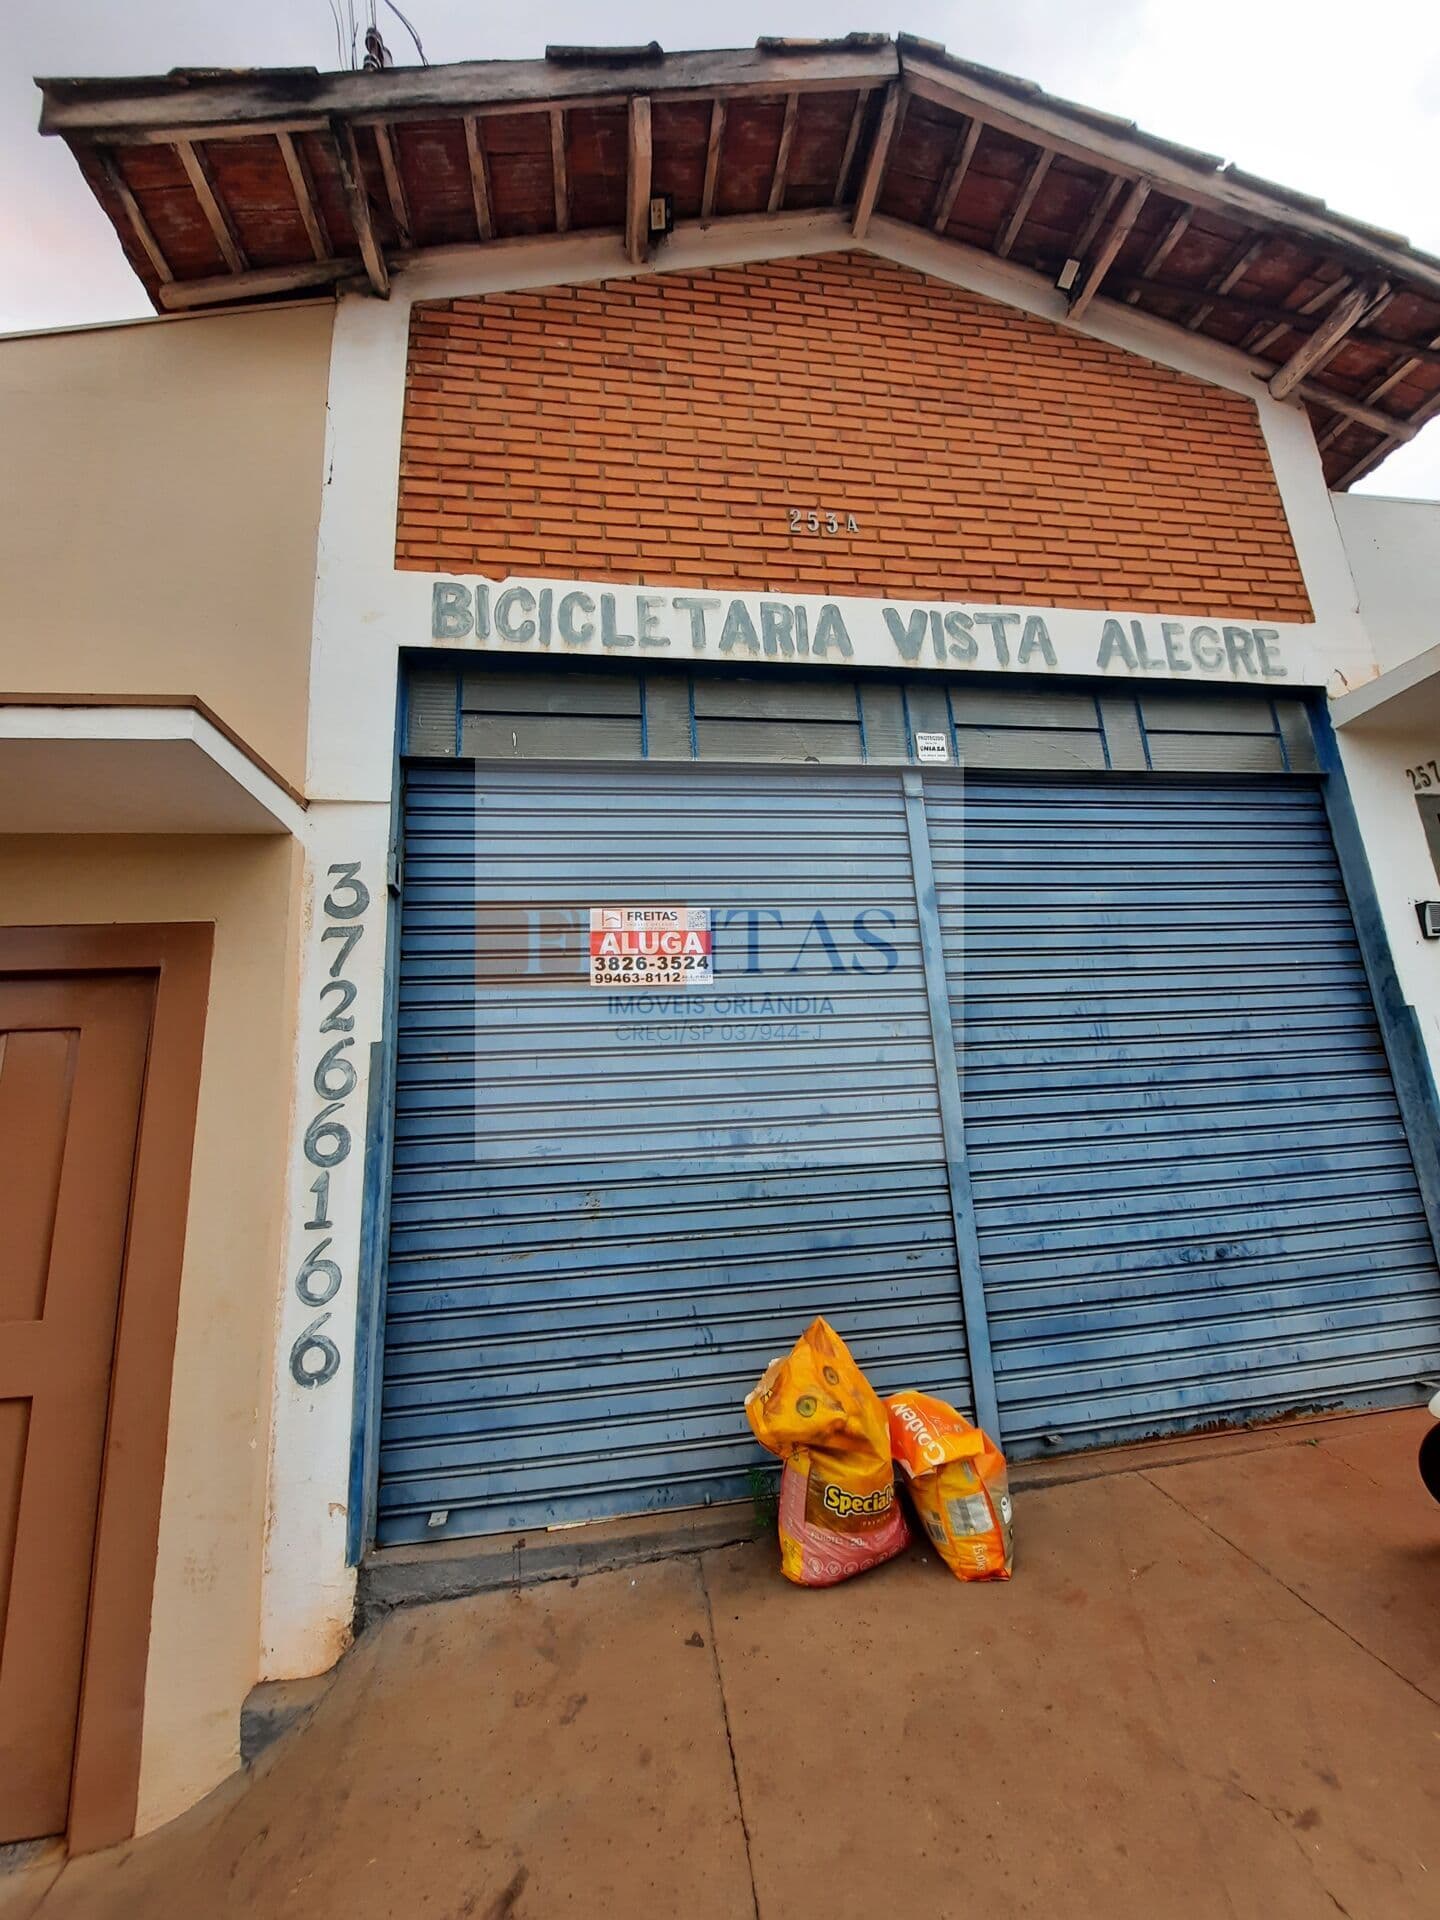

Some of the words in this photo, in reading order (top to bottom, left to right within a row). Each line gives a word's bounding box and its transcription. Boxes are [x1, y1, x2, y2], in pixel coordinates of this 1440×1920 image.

[432, 582, 854, 656] BICICLETARIA
[882, 607, 1058, 666] VISTA
[1096, 619, 1288, 677] ALEGRE
[1405, 760, 1440, 790] 257
[627, 911, 678, 921] FREITAS
[599, 931, 705, 955] ALUGA
[594, 956, 709, 971] 3826-3524
[594, 972, 681, 984] 99463-8112
